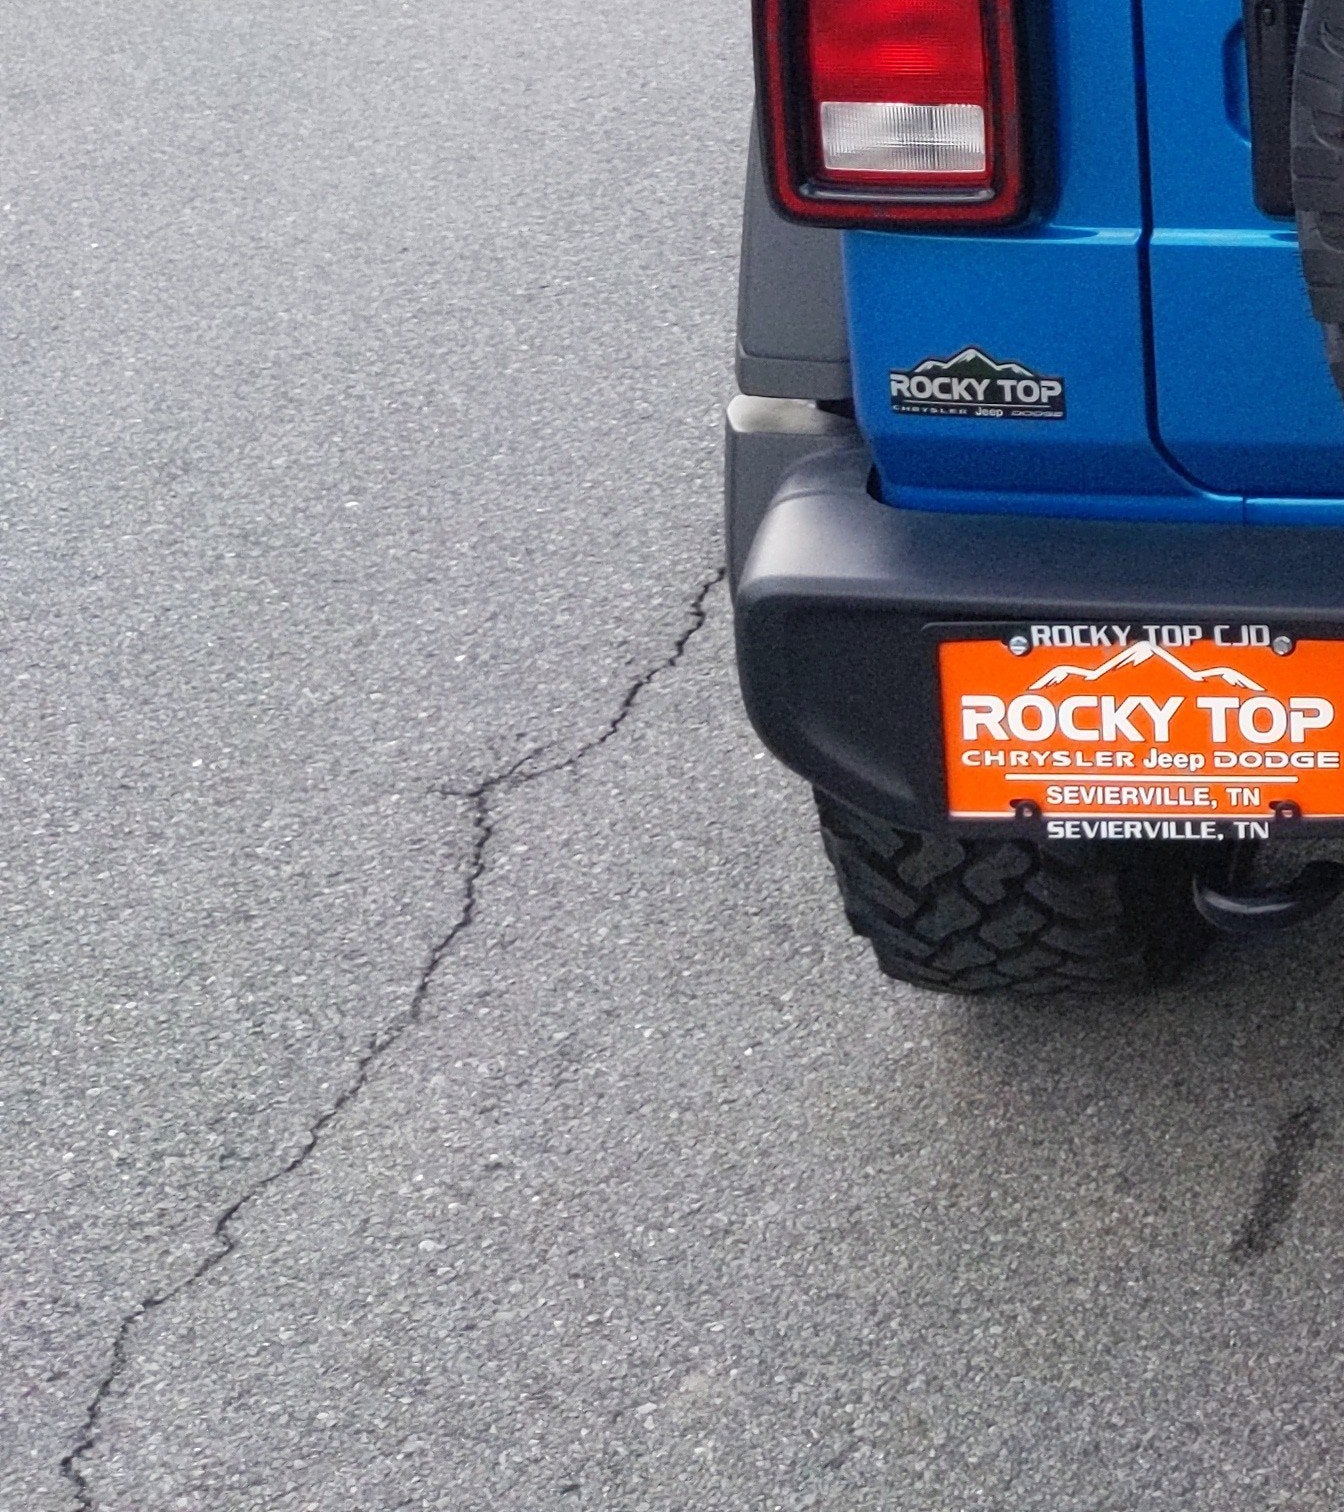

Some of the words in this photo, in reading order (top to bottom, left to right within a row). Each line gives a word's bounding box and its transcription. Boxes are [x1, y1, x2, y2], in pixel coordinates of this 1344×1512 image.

[890, 374, 990, 401] ROCKY
[997, 379, 1062, 403] TOP
[976, 406, 1003, 417] Jeep
[1031, 625, 1133, 647] ROCKY
[1144, 625, 1203, 647] TOP
[1214, 625, 1270, 647] CJD
[961, 695, 1184, 742] ROCKY
[1197, 696, 1335, 743] TOP
[961, 750, 1135, 768] CHRYSLER
[1143, 748, 1205, 771] Jeep
[1214, 751, 1340, 769] DODGE
[1046, 786, 1218, 808] SEVIERVILLE,
[1225, 787, 1260, 806] TN
[1047, 820, 1225, 841] SEVIERVILLE,
[1234, 821, 1269, 839] TN
